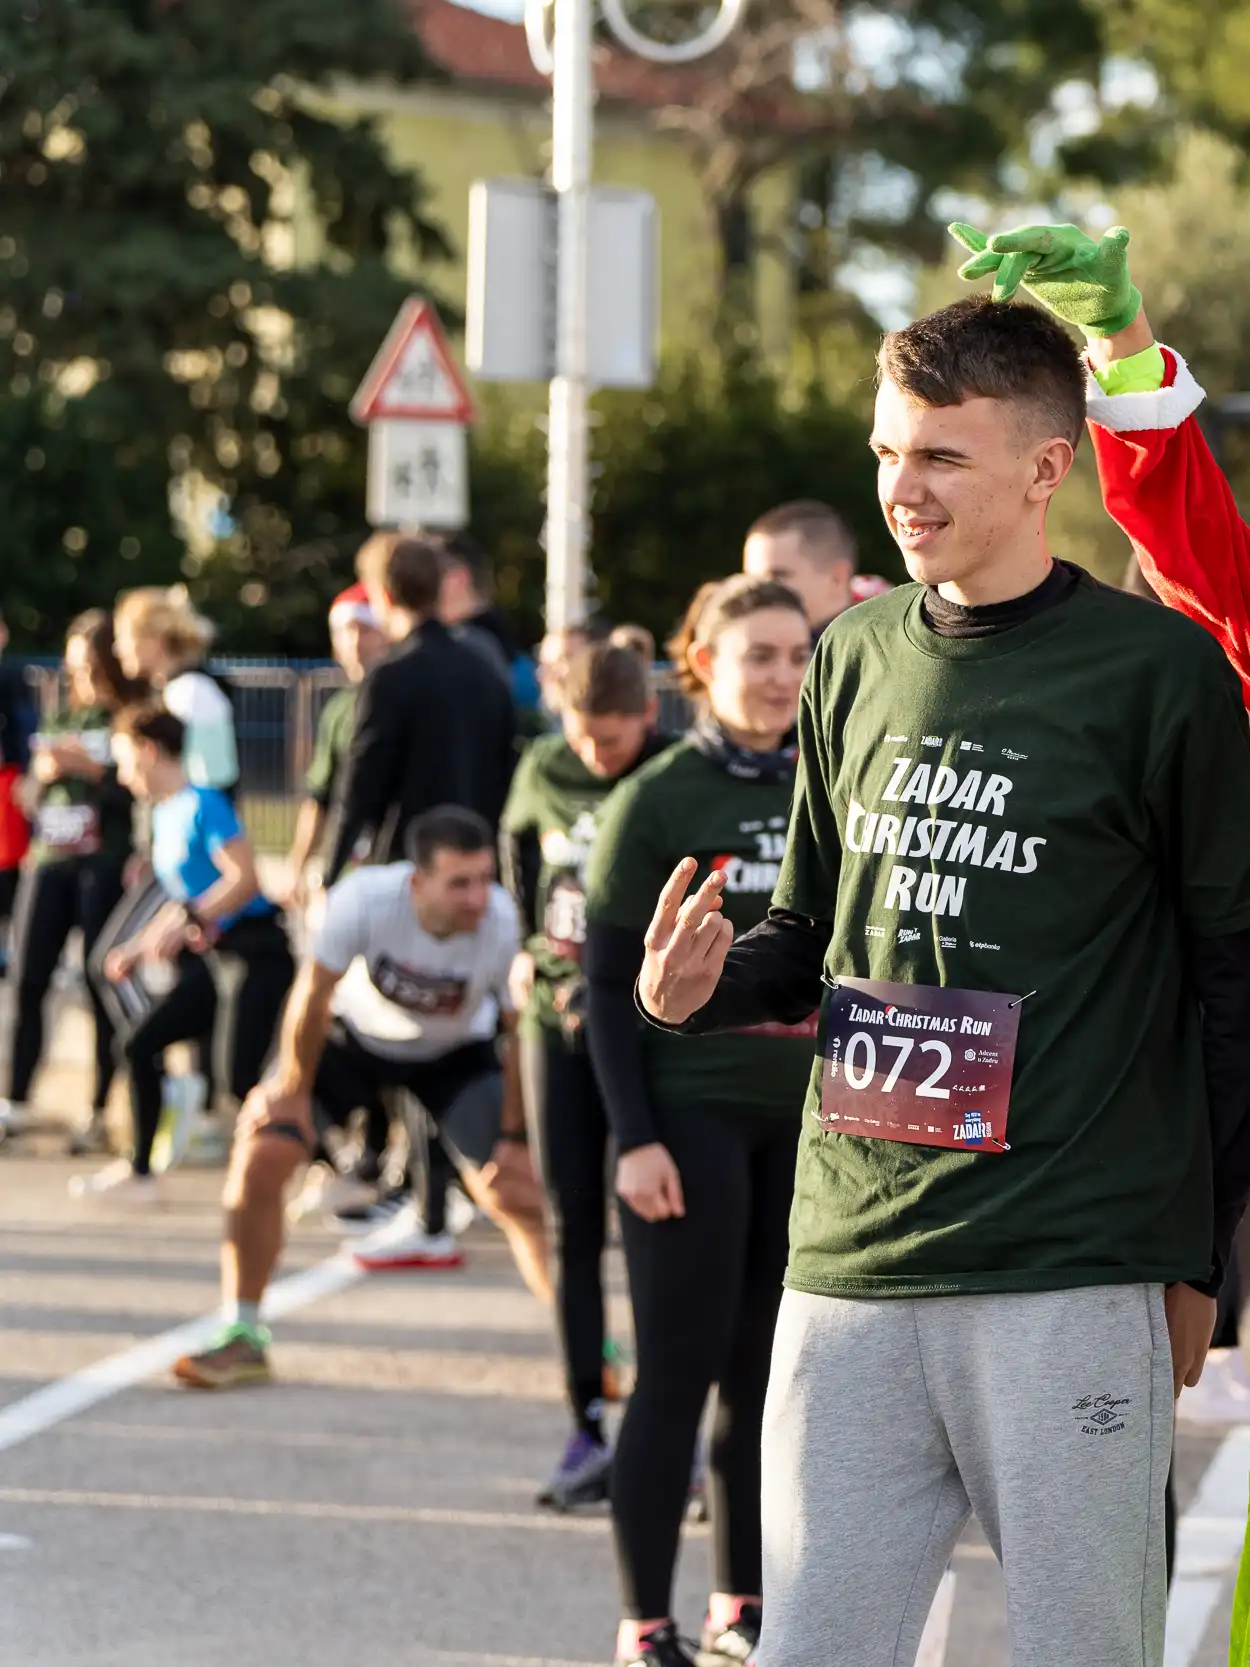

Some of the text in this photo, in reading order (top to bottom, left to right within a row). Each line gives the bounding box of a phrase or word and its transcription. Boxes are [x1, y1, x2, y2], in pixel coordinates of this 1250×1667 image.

[882, 757, 1013, 817] ZADAR
[884, 865, 967, 917] RUN
[848, 1003, 993, 1037] ZADAR CHRISTMAS RUN
[844, 1031, 953, 1100] 072
[1072, 1393, 1132, 1410] Lee Cooper
[1081, 1421, 1125, 1436] EAST LONDON
